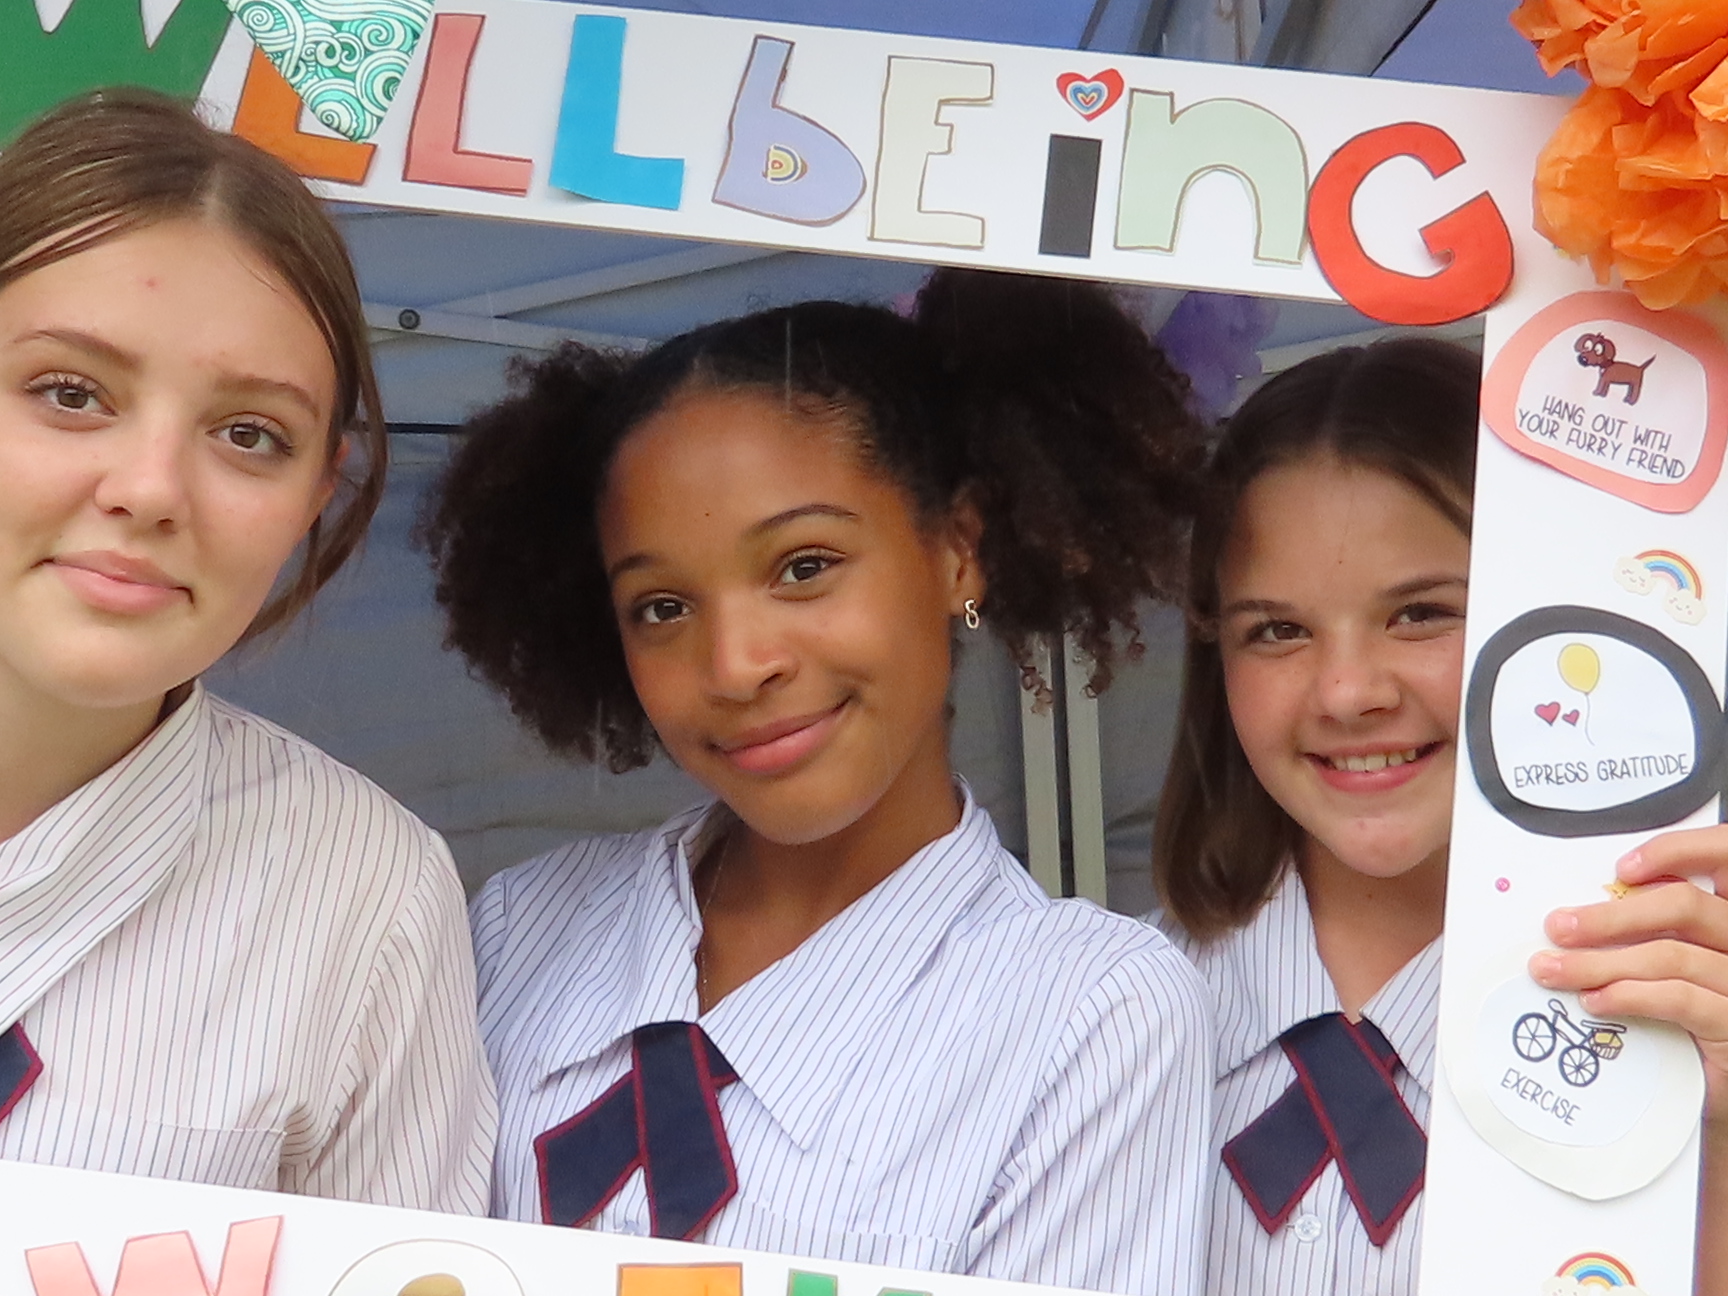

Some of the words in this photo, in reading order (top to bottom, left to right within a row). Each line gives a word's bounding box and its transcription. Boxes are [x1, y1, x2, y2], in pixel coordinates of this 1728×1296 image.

[1517, 408, 1560, 440] YOUR
[1565, 428, 1623, 462] FURRY
[1626, 447, 1686, 480] FRIEND
[1542, 395, 1584, 427] HANG
[1591, 413, 1628, 440] OUT
[1633, 424, 1673, 453] WITH
[1513, 761, 1590, 789] EXPRESS
[1596, 753, 1690, 782] GRATITUDE
[1499, 1066, 1582, 1127] EXERCISE
